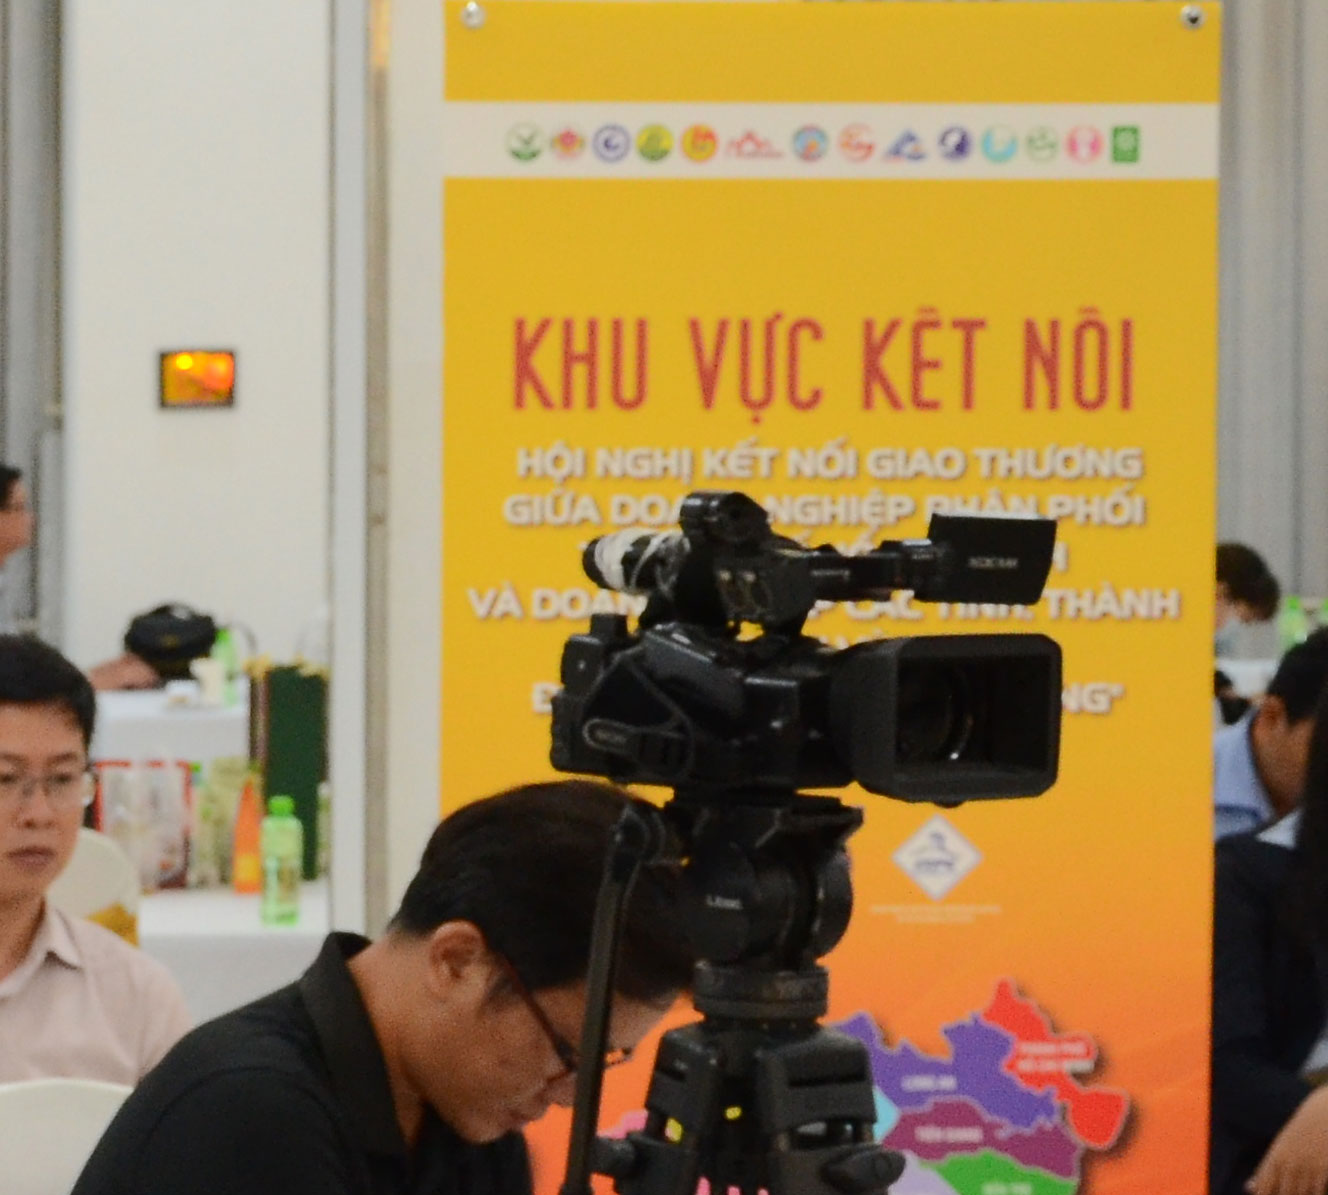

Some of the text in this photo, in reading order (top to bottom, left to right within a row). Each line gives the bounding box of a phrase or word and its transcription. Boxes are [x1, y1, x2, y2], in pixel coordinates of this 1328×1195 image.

[512, 315, 648, 411] KHU
[687, 310, 825, 426] VỰC
[516, 436, 1144, 486] HỘI NGHỊ KẾT NỐI GIAO THƯƠNG
[501, 487, 603, 527] GIỮA
[765, 486, 917, 527] NGHIỆP
[1047, 481, 1147, 526] PHỐI
[466, 580, 524, 620] VÀ
[531, 587, 649, 619] DOAN
[1042, 580, 1182, 621] THÀNH
